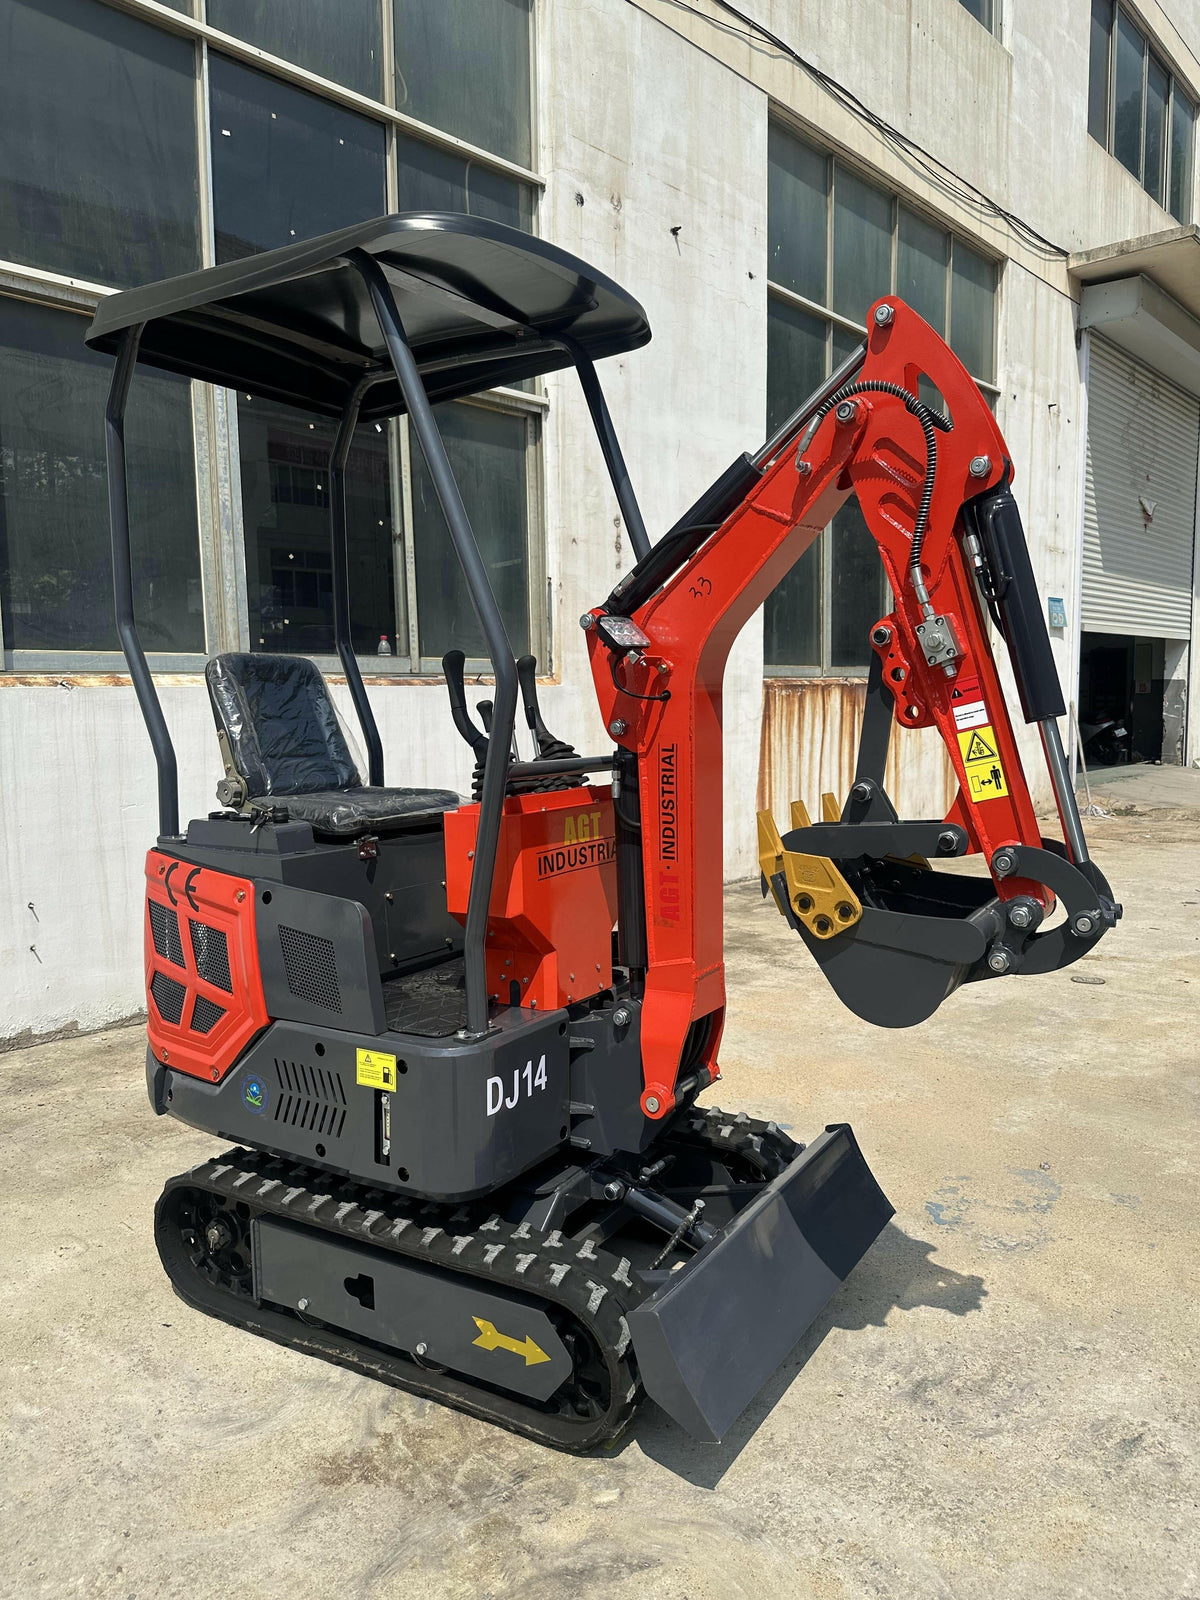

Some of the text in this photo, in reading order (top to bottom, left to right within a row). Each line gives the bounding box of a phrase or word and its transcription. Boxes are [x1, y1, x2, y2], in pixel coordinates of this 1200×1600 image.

[563, 812, 602, 846] AGT
[659, 743, 680, 922] AGT INDUSTRIAL
[537, 841, 617, 876] INDUSTRIA
[486, 1054, 548, 1117] DJ14
